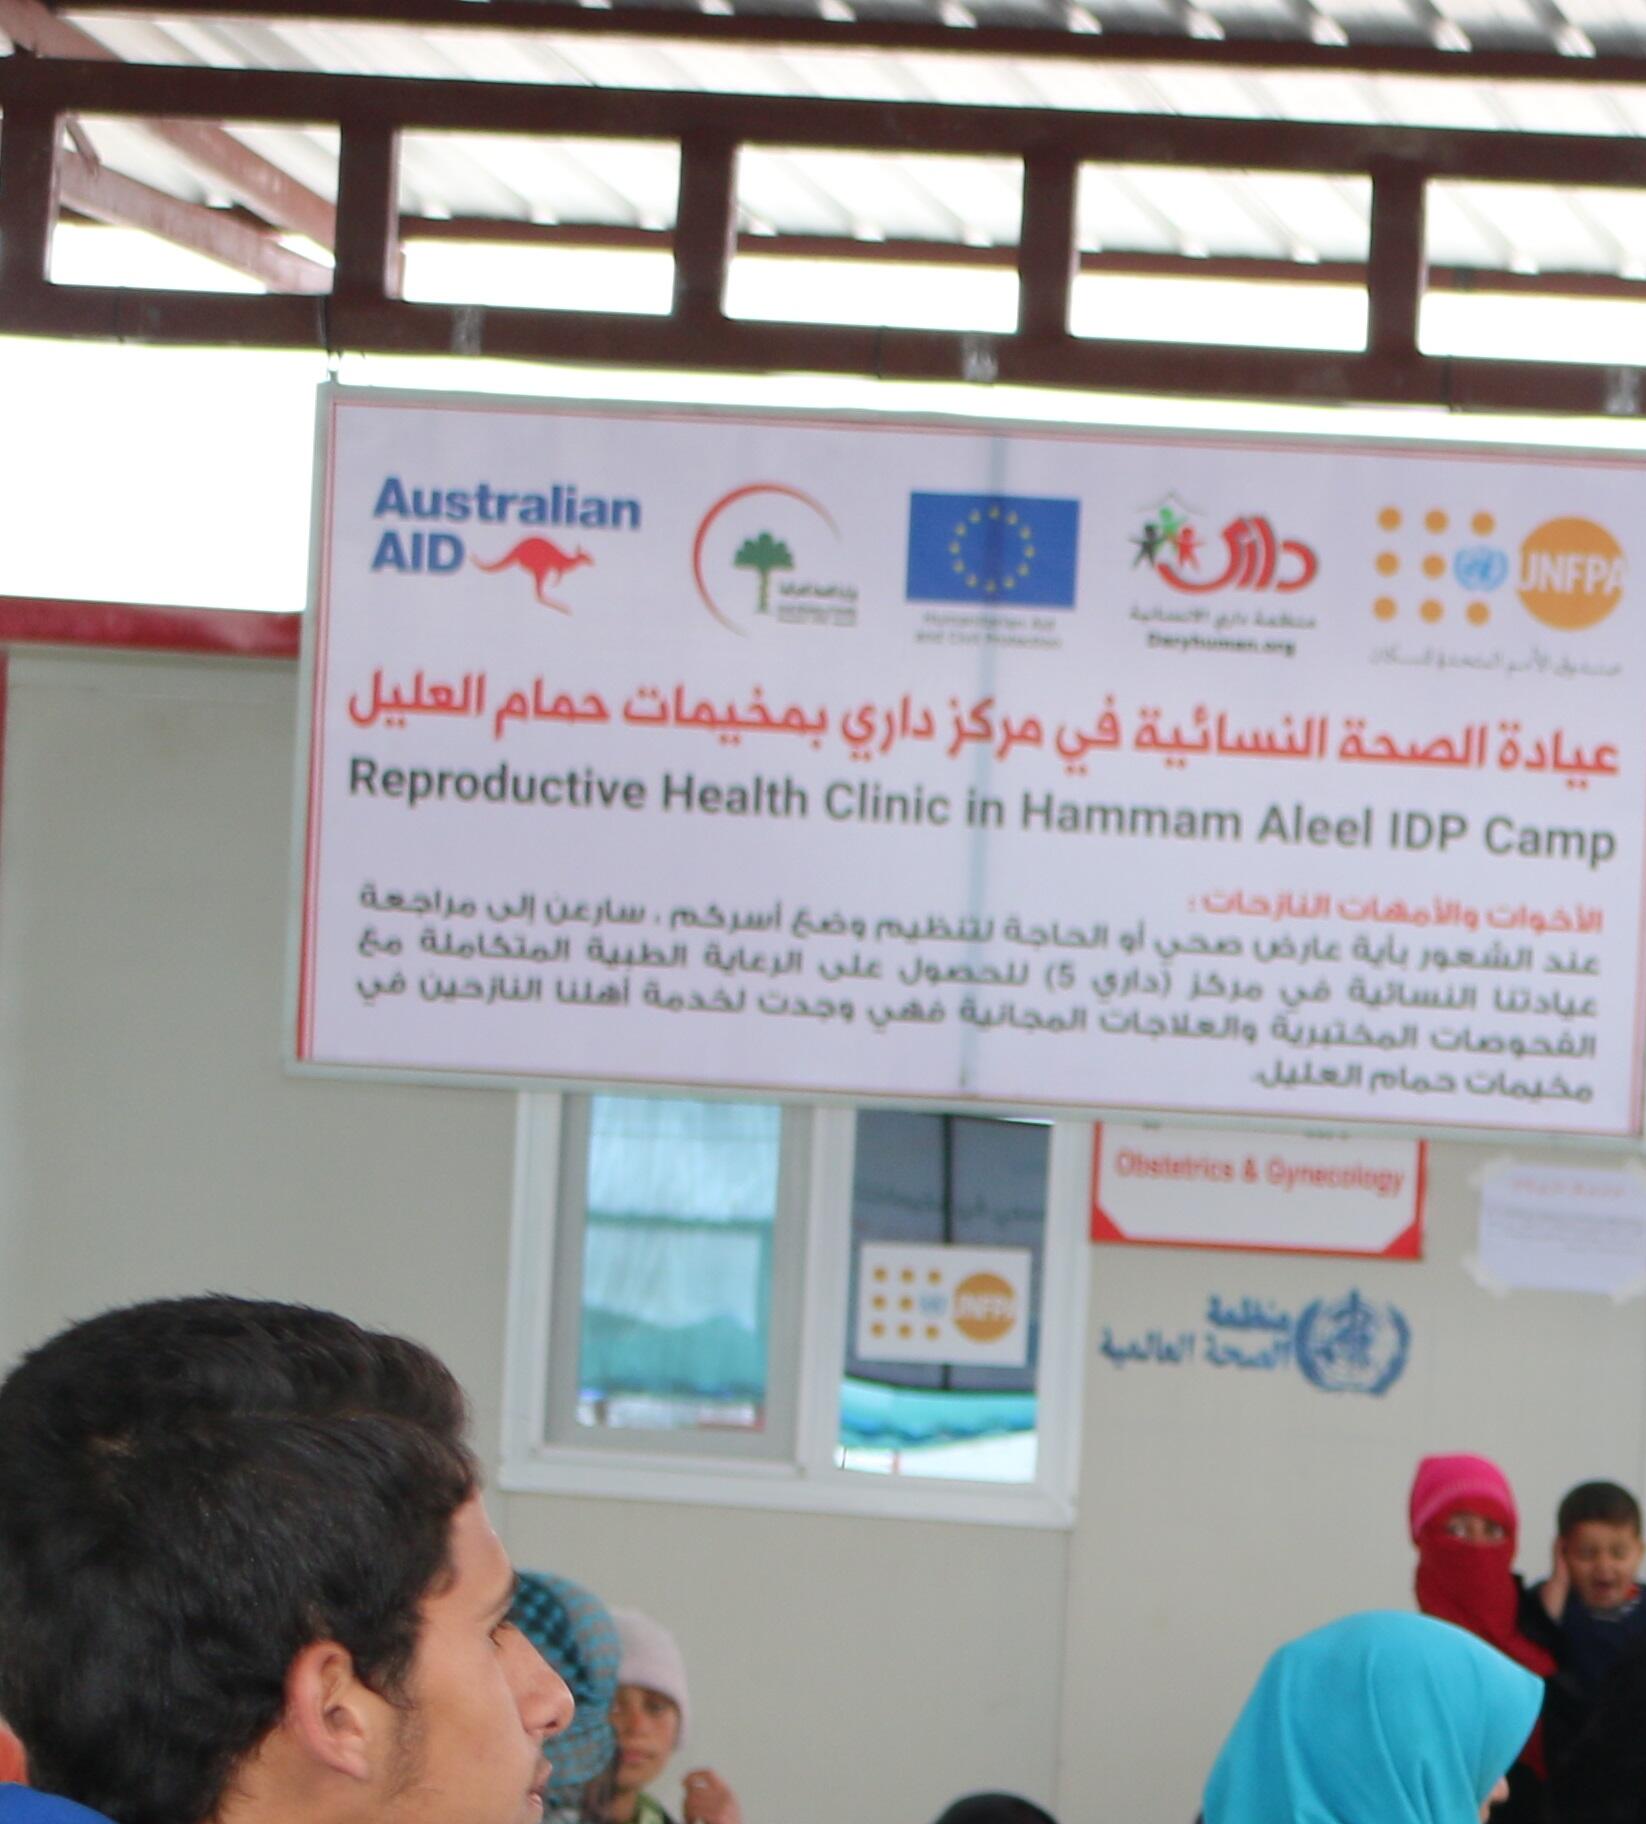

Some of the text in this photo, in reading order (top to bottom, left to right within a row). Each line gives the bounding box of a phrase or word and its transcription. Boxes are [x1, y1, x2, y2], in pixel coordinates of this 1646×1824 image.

[372, 476, 641, 530] Australian
[370, 531, 465, 574] AID
[348, 667, 1620, 789] عيادة الصحة النسائية في مركز داري بمخيمات حمام العليل
[350, 756, 1616, 870] Reproductive Health Clinic in Hammam Aleel IDP Camp
[358, 881, 477, 920] مراجعة
[358, 923, 403, 957] مع
[791, 906, 866, 941] وضع
[876, 911, 994, 944] لتنظيم
[1003, 915, 1109, 951] الحاجة
[420, 924, 571, 963] المتكاملة
[586, 932, 689, 970] الطبية
[703, 939, 803, 977] الرعاية
[1153, 934, 1243, 966] صحي
[1253, 935, 1341, 965] عارض
[1418, 940, 1533, 971] الشعور
[818, 951, 882, 981] على
[898, 956, 1029, 987] للحصول
[1543, 952, 1600, 975] عند
[356, 971, 407, 1007] في
[419, 970, 542, 1004] النازحين
[1190, 969, 1264, 1002] مركز
[1280, 976, 1331, 1013] في
[1494, 986, 1598, 1020] عيادتنا
[758, 989, 855, 1026] وجدت
[957, 992, 1088, 1035] المجانية
[1098, 1005, 1259, 1044] والعلاجات
[1269, 1010, 1418, 1050] المختبرية
[1430, 1027, 1597, 1060] الفحوصات
[1369, 1063, 1457, 1095] حمام
[1465, 1071, 1594, 1106] مخيمات
[1114, 1148, 1405, 1198] Obstetrics & Gynecology
